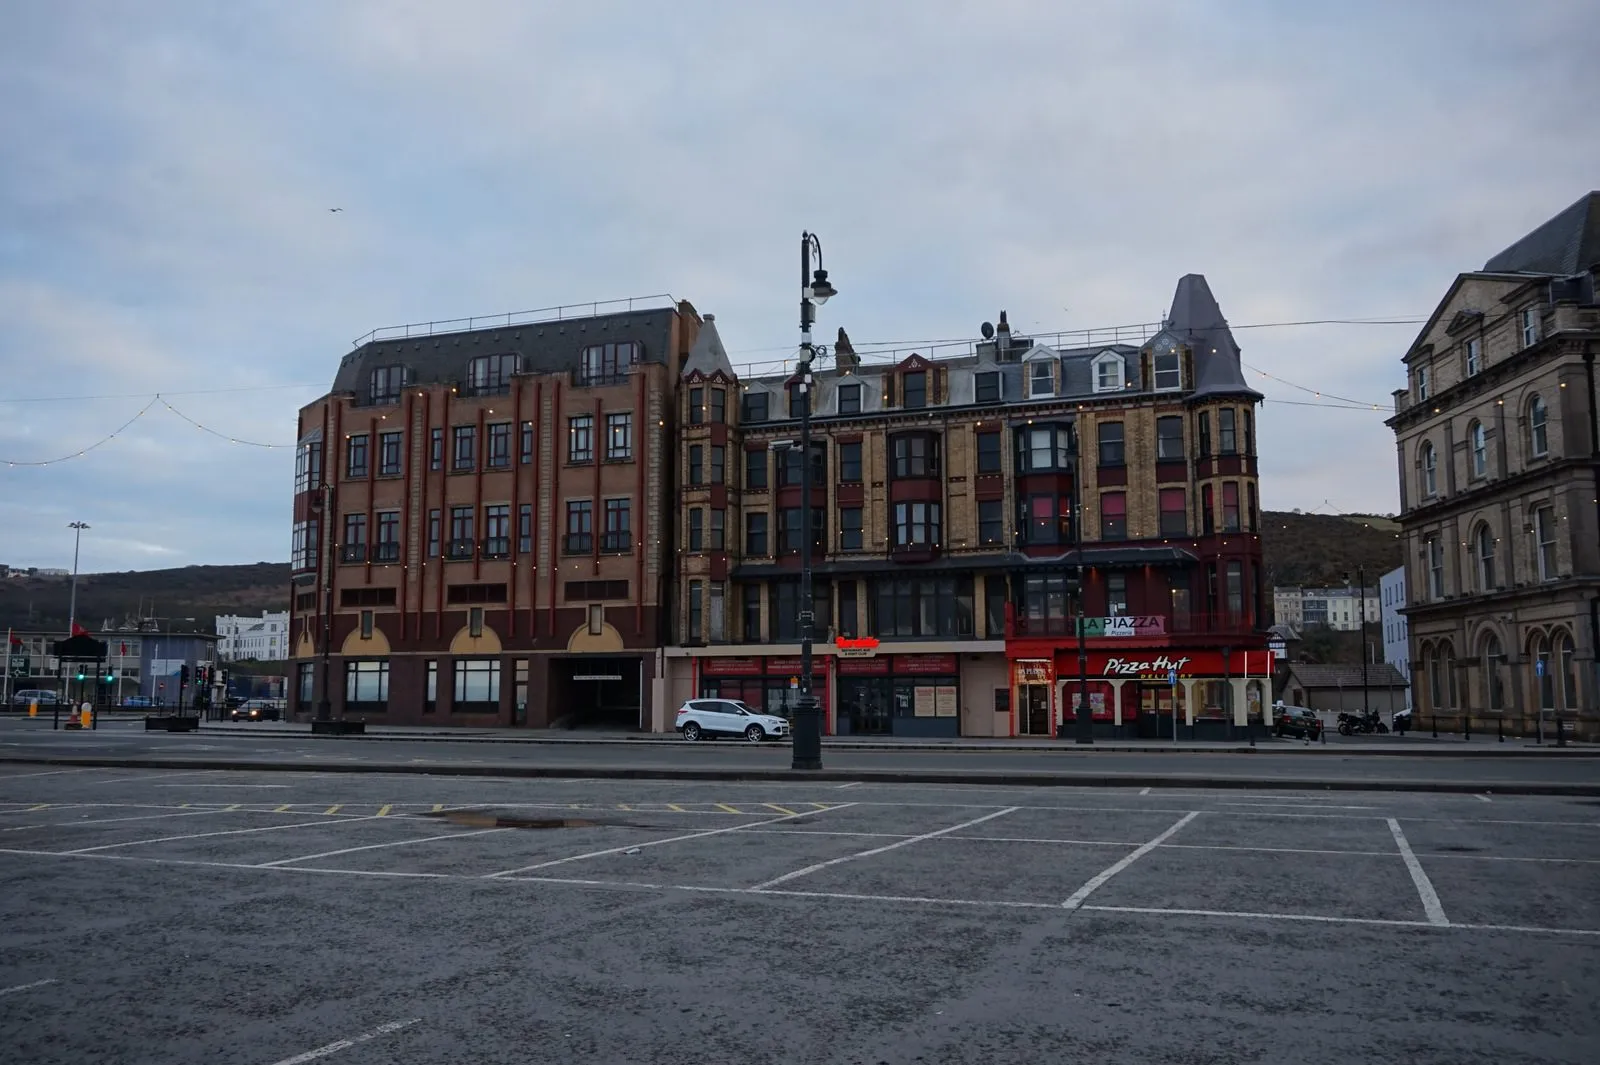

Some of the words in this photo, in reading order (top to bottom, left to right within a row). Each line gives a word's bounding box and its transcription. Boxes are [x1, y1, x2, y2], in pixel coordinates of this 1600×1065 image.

[1079, 618, 1099, 629] A
[1103, 616, 1160, 628] PIAZZA
[1103, 657, 1150, 676] Pizza
[1152, 655, 1191, 672] Hut
